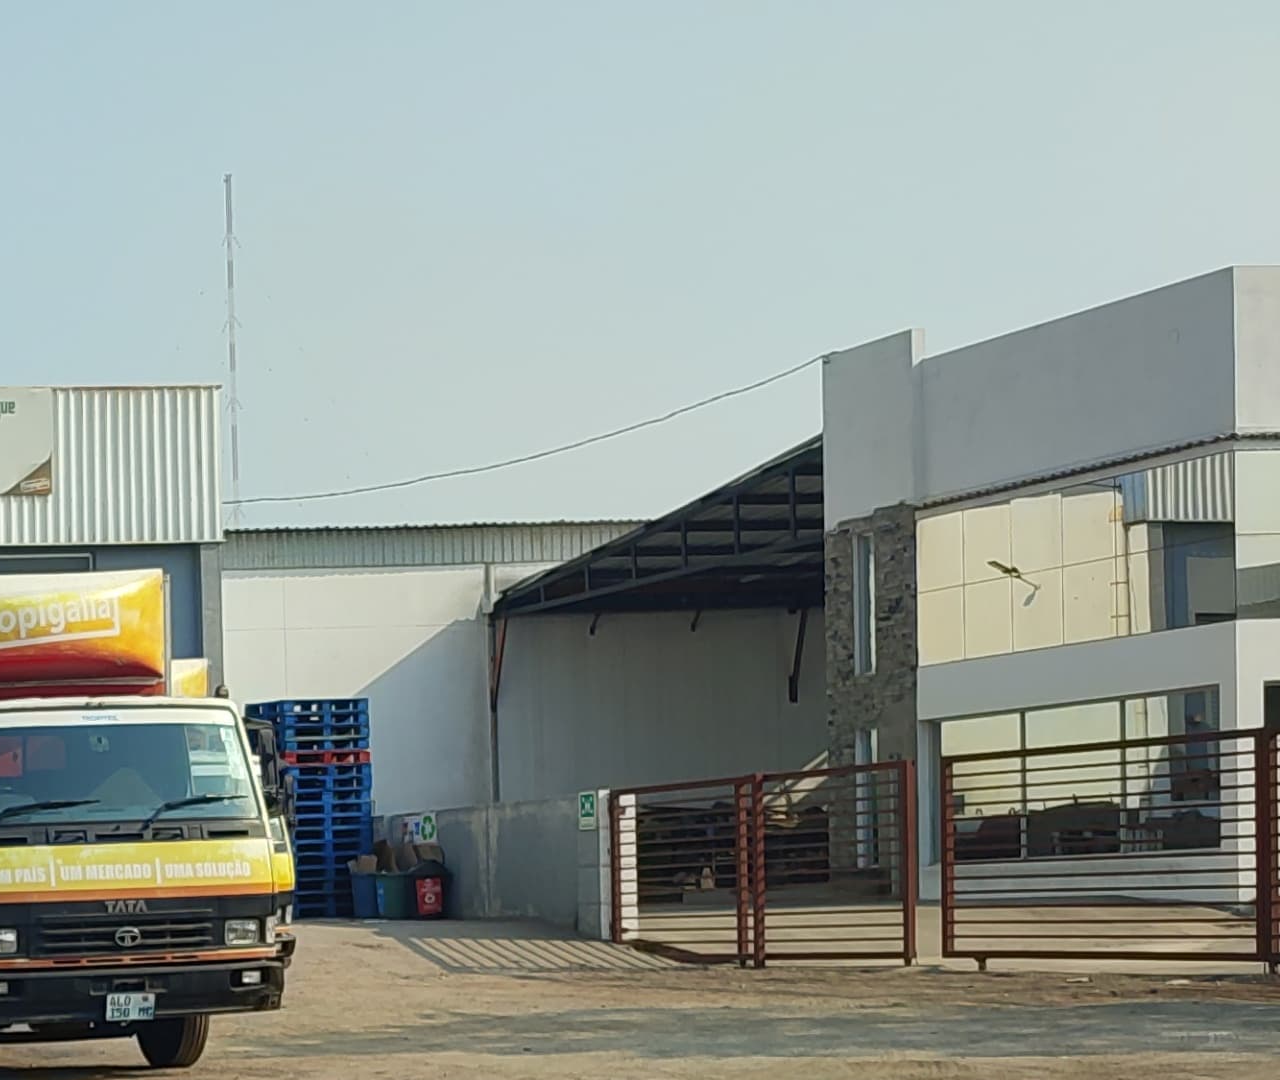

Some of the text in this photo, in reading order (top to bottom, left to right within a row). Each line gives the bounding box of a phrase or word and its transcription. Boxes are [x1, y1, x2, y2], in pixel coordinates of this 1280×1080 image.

[60, 865, 82, 881] UM
[85, 863, 152, 881] MERCADO
[165, 862, 193, 878] UMA
[195, 860, 251, 879] SOLUÇÃO
[104, 900, 148, 913] TATA
